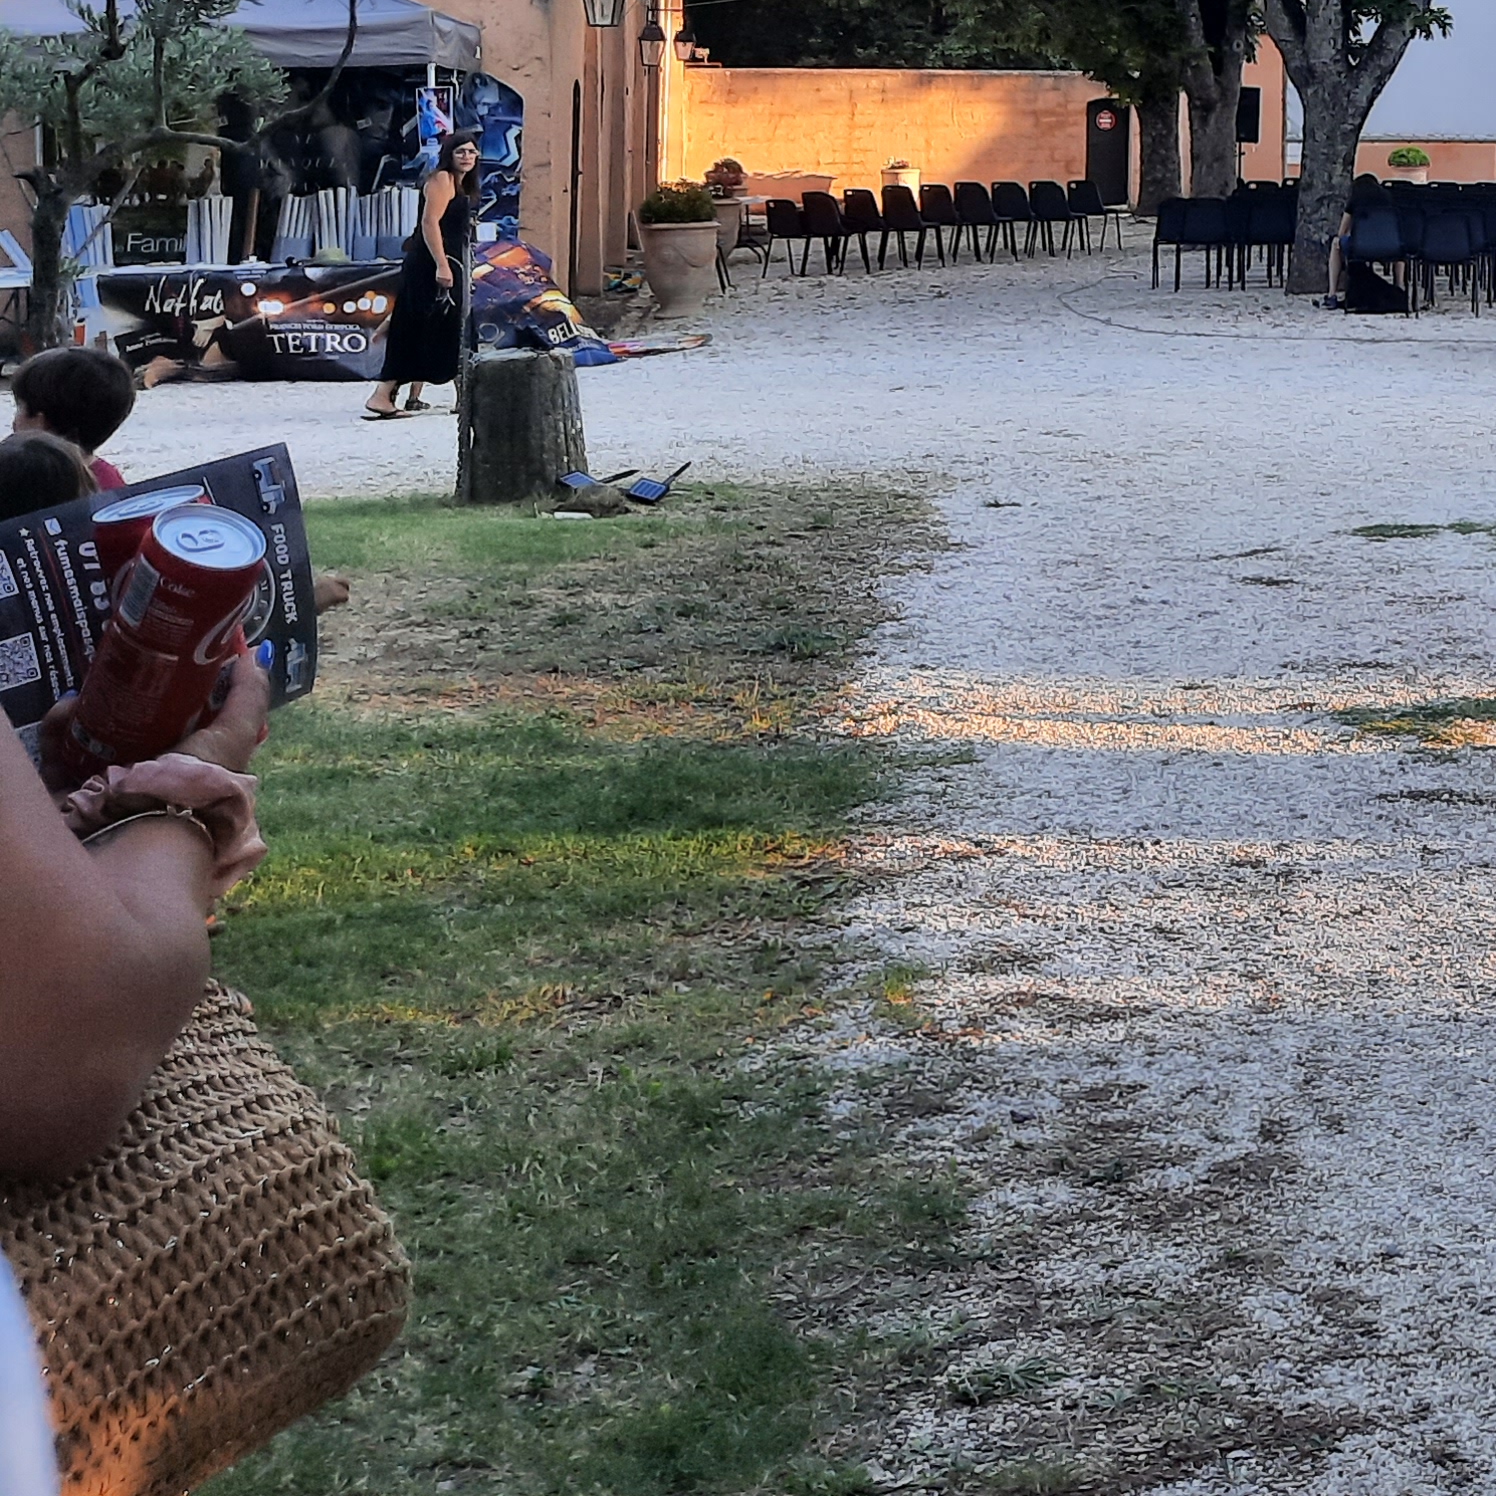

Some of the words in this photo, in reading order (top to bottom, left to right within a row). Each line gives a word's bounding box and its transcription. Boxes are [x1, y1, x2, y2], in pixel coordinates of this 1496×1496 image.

[266, 331, 367, 353] TETRO
[271, 523, 290, 565] FOOD
[280, 569, 298, 624] TRUCK
